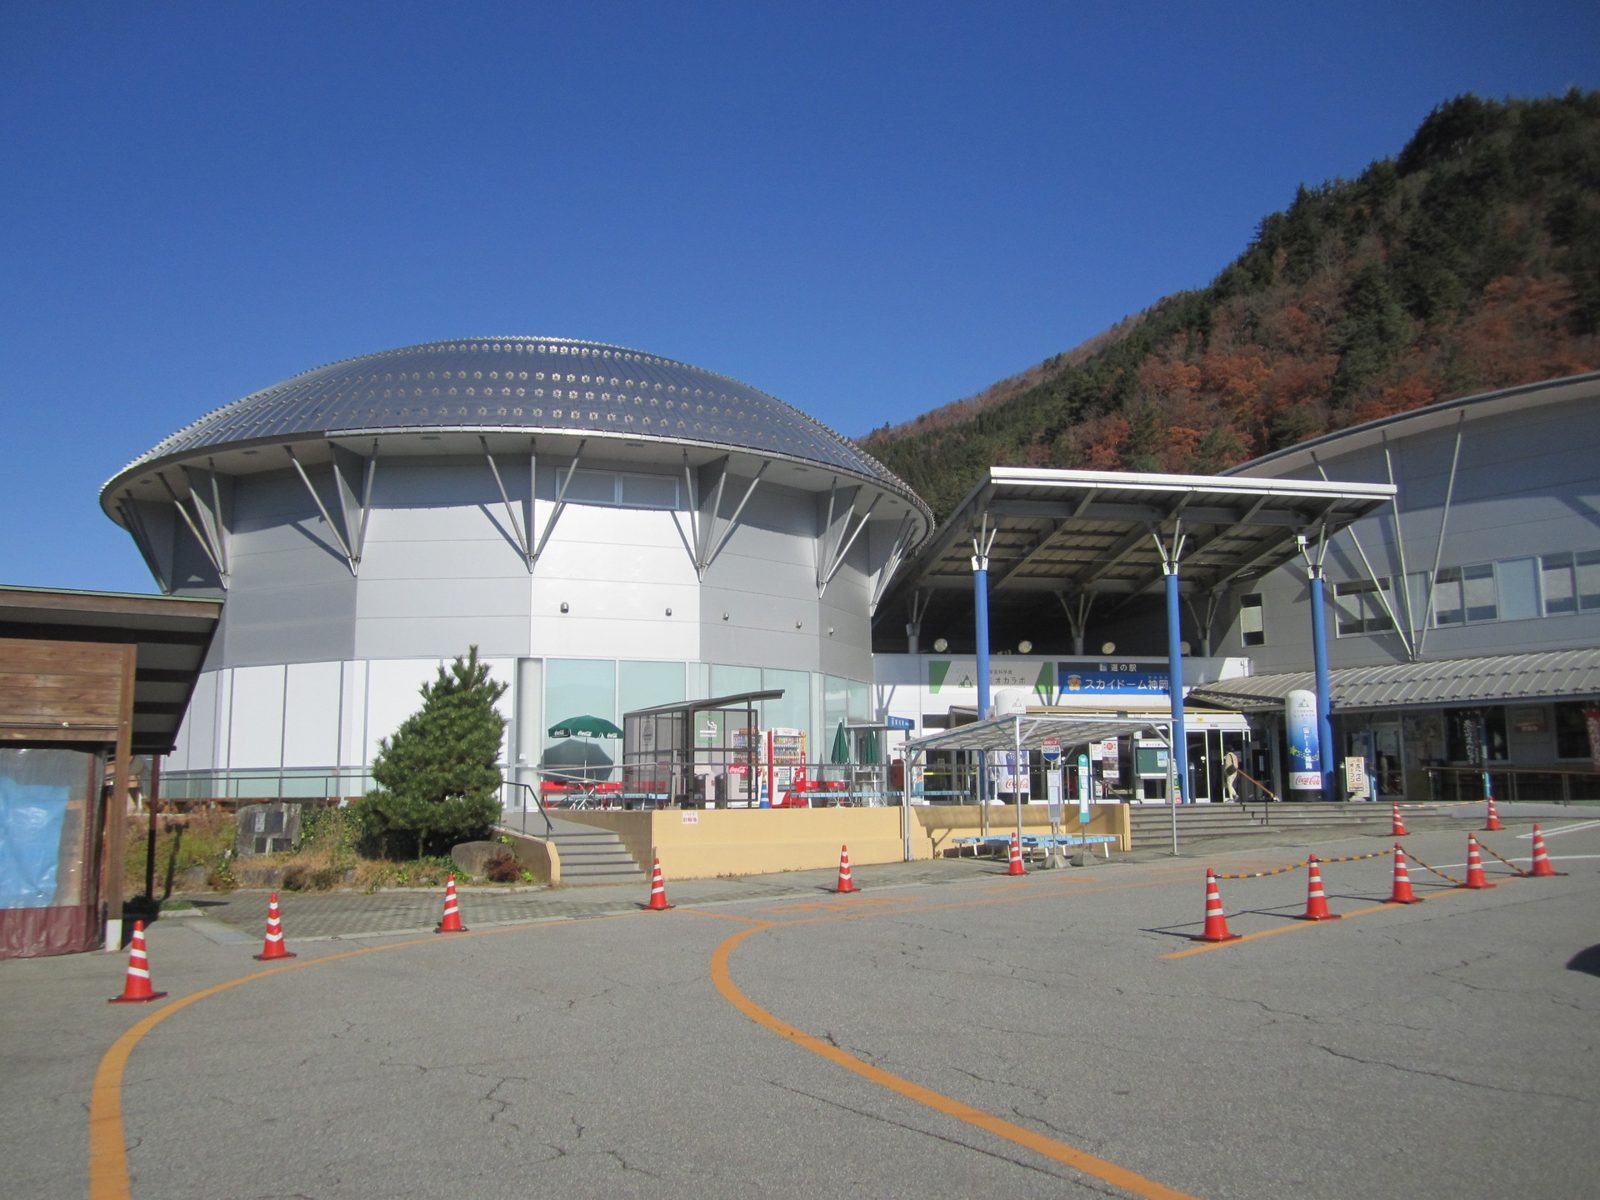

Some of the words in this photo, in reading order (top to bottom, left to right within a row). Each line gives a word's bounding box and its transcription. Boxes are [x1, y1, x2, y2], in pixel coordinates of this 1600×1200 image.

[1110, 664, 1137, 672] 道の駅
[1084, 679, 1169, 690] スカイドーム神岡
